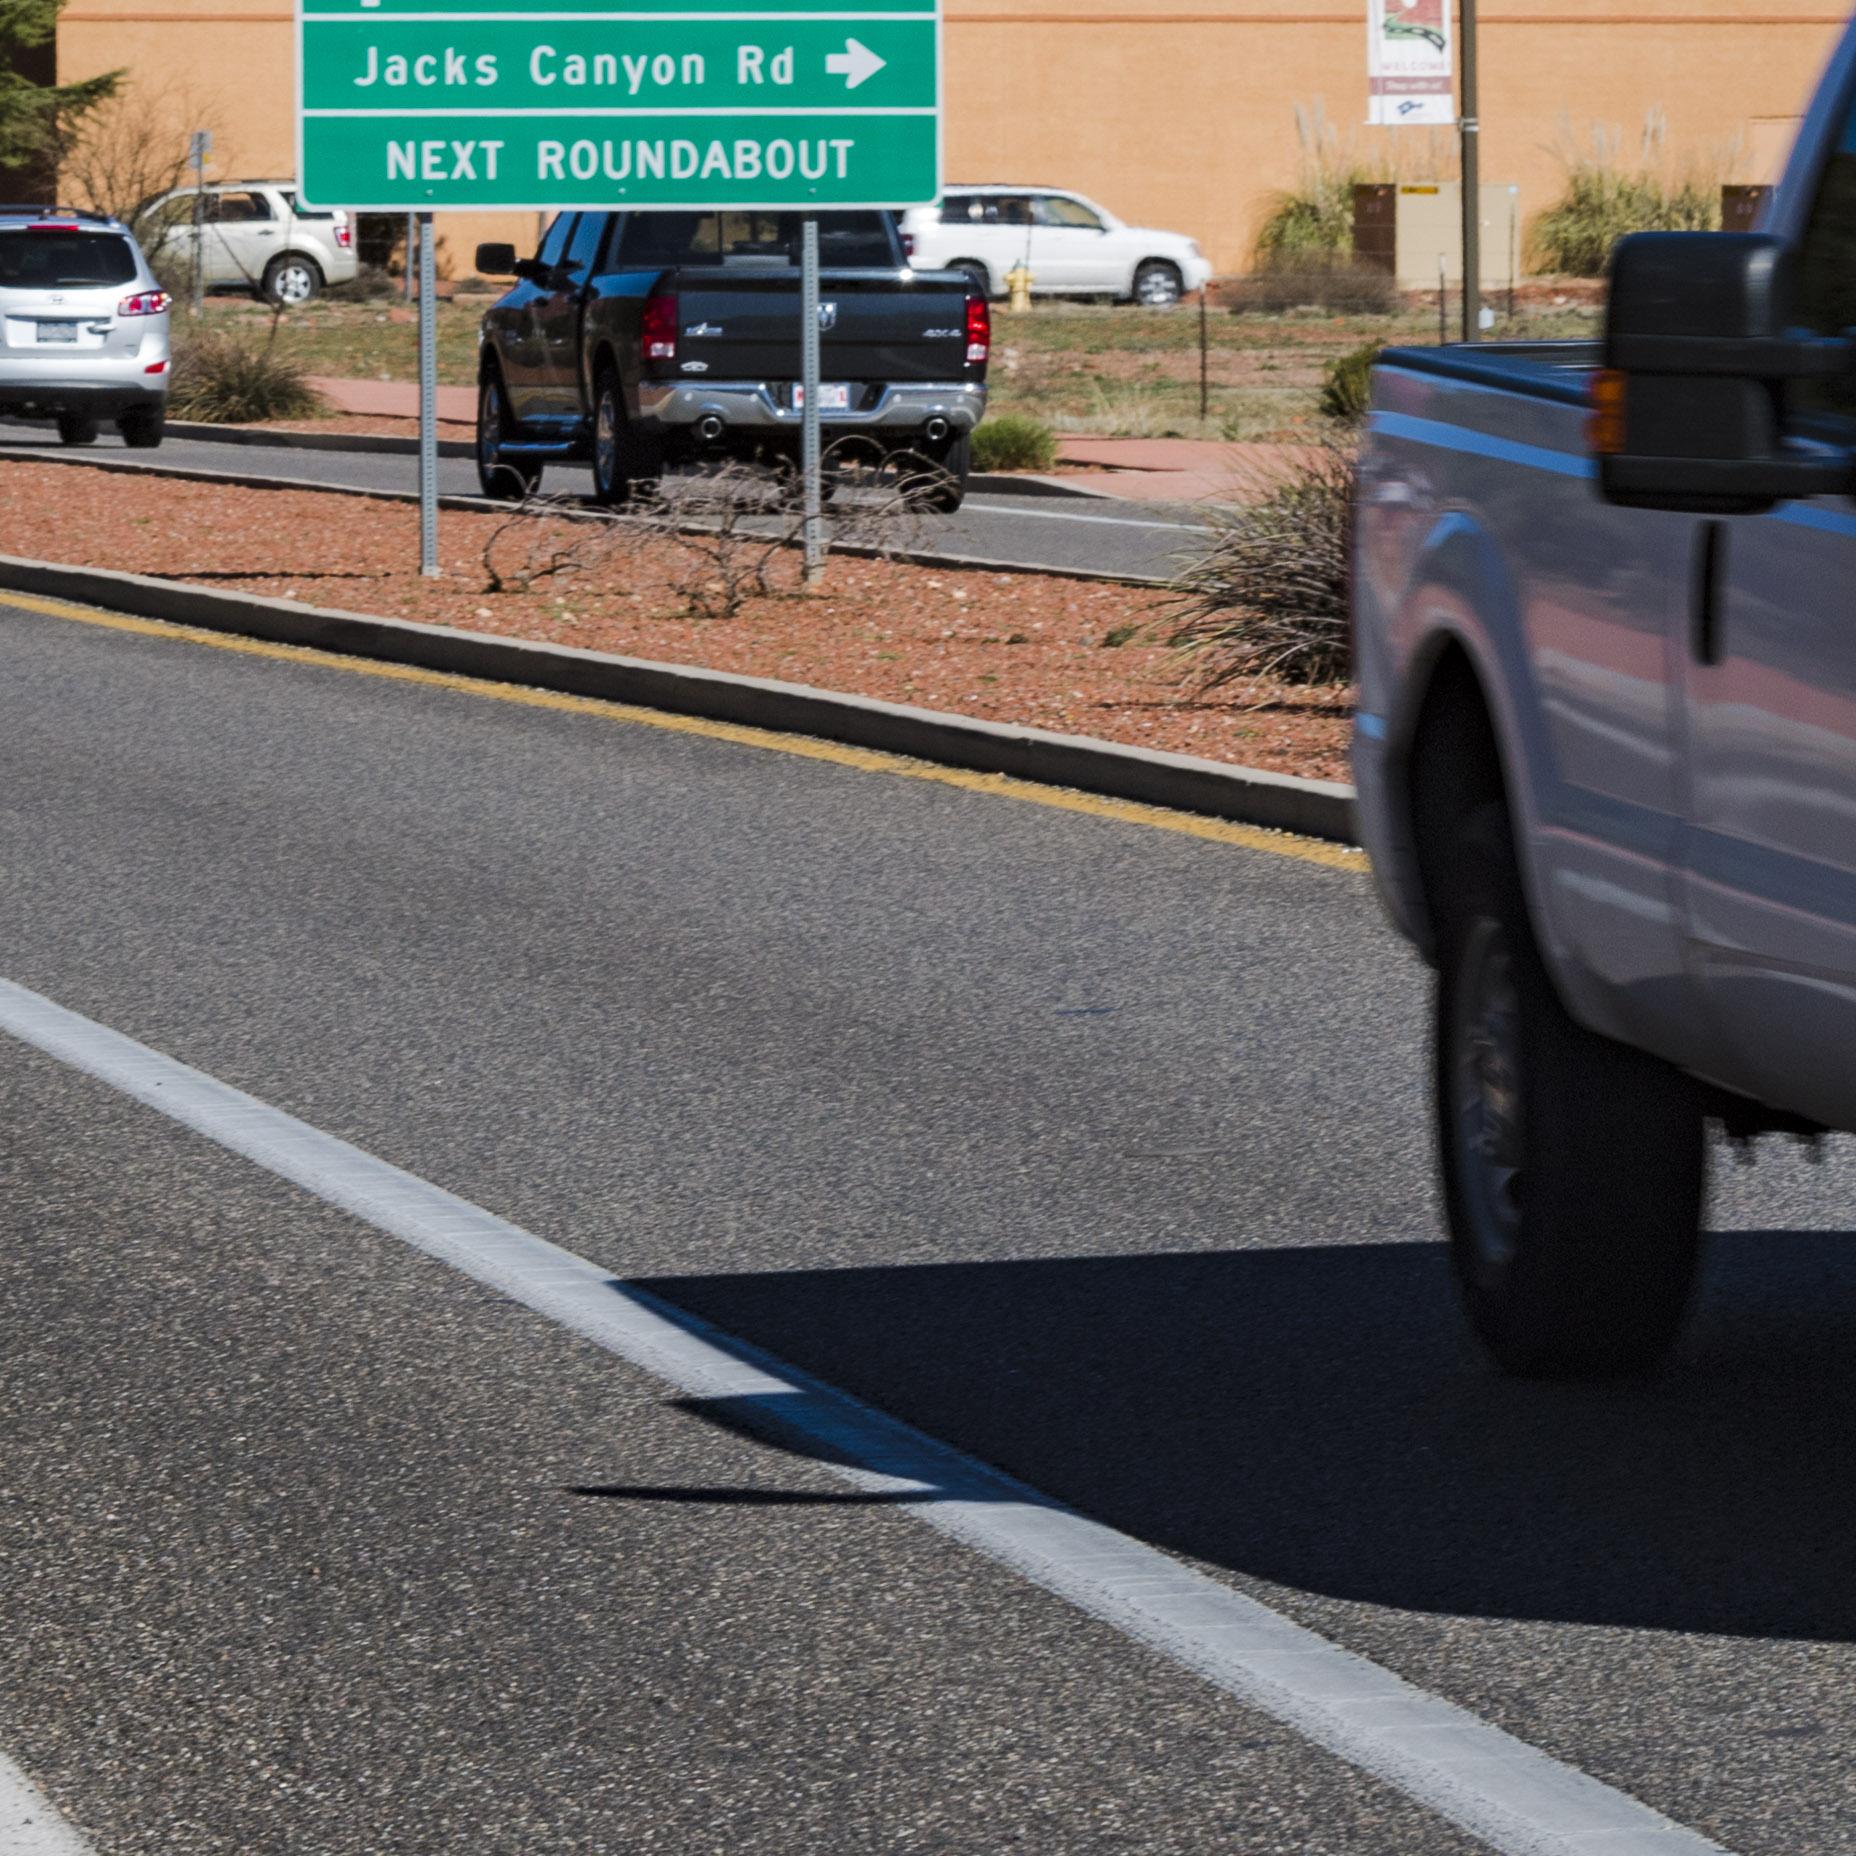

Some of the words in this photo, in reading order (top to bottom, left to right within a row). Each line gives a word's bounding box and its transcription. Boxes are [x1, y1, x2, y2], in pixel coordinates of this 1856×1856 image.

[353, 45, 499, 87] Jacks
[529, 44, 706, 95] Canyon
[736, 44, 794, 86] Rd
[386, 140, 505, 181] NEXT
[537, 139, 855, 181] ROUNDABOUT
